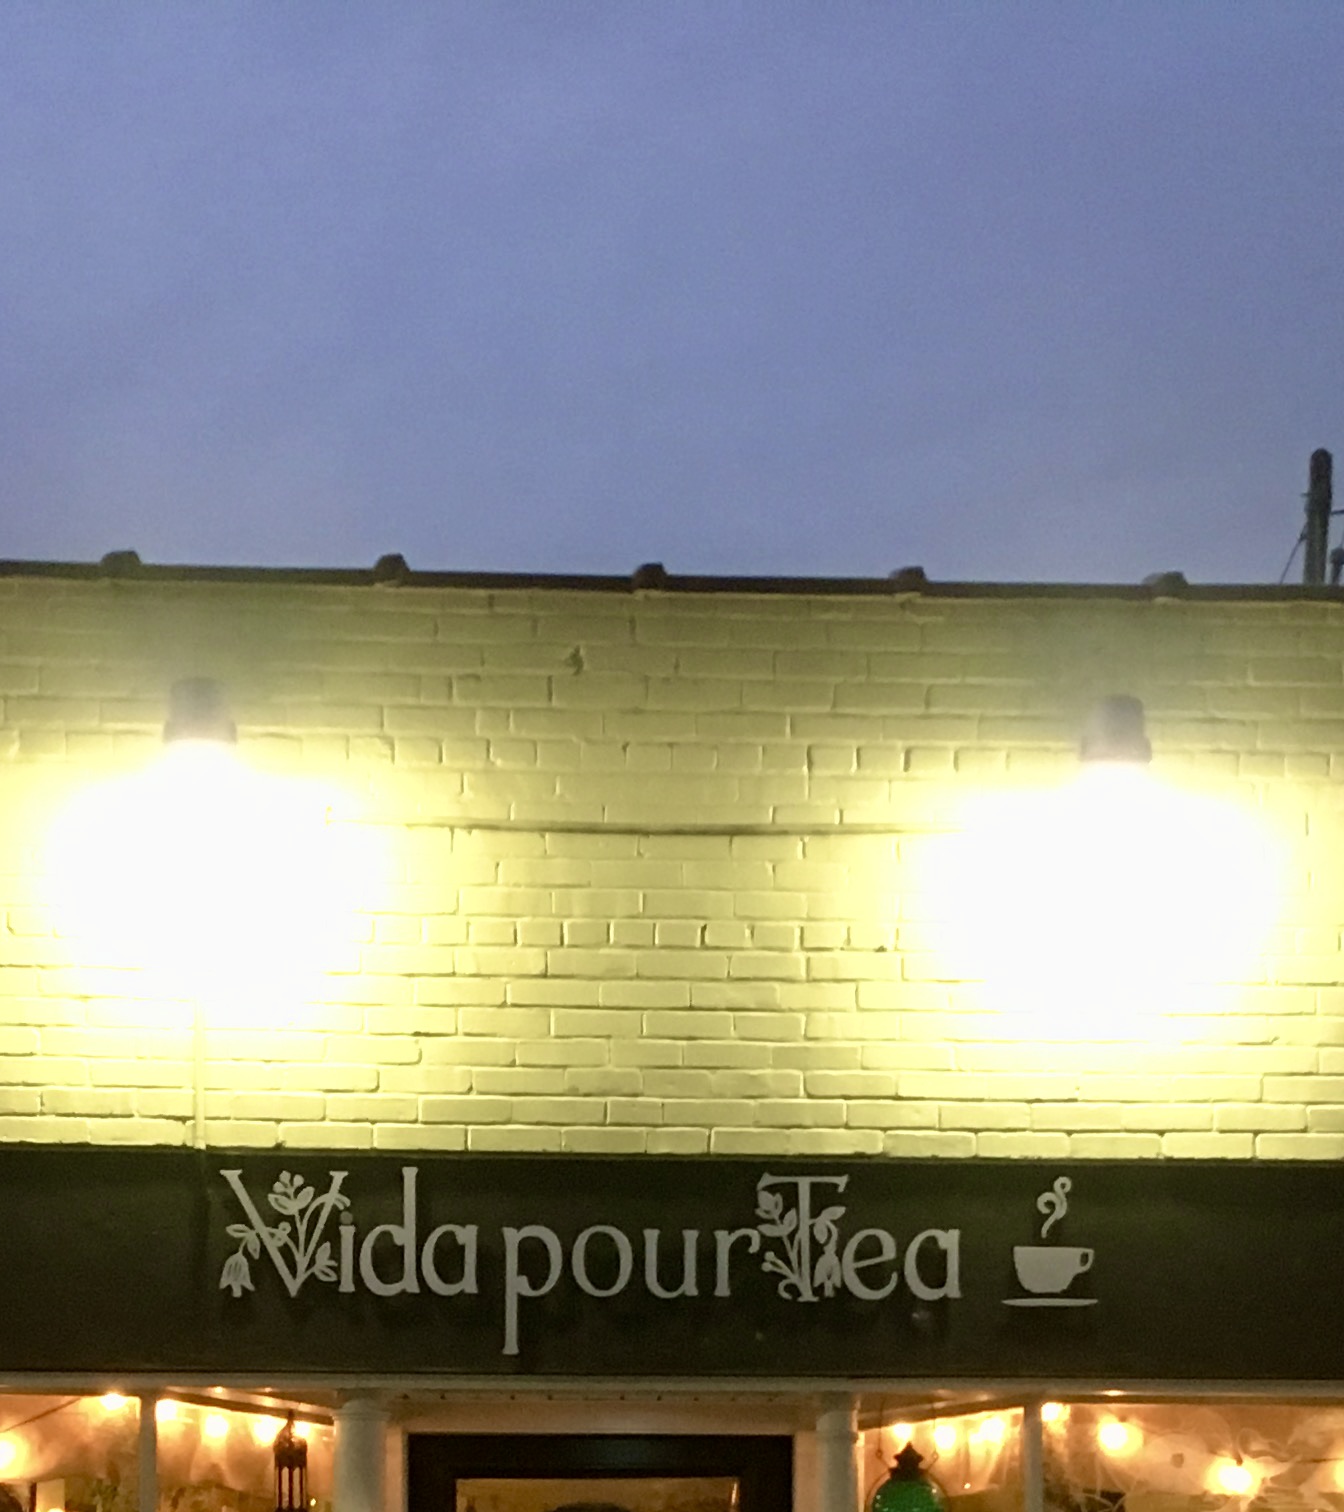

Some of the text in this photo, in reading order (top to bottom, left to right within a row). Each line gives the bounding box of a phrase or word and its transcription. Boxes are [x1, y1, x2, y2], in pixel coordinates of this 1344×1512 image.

[220, 1166, 962, 1356] Vida pour Tea
